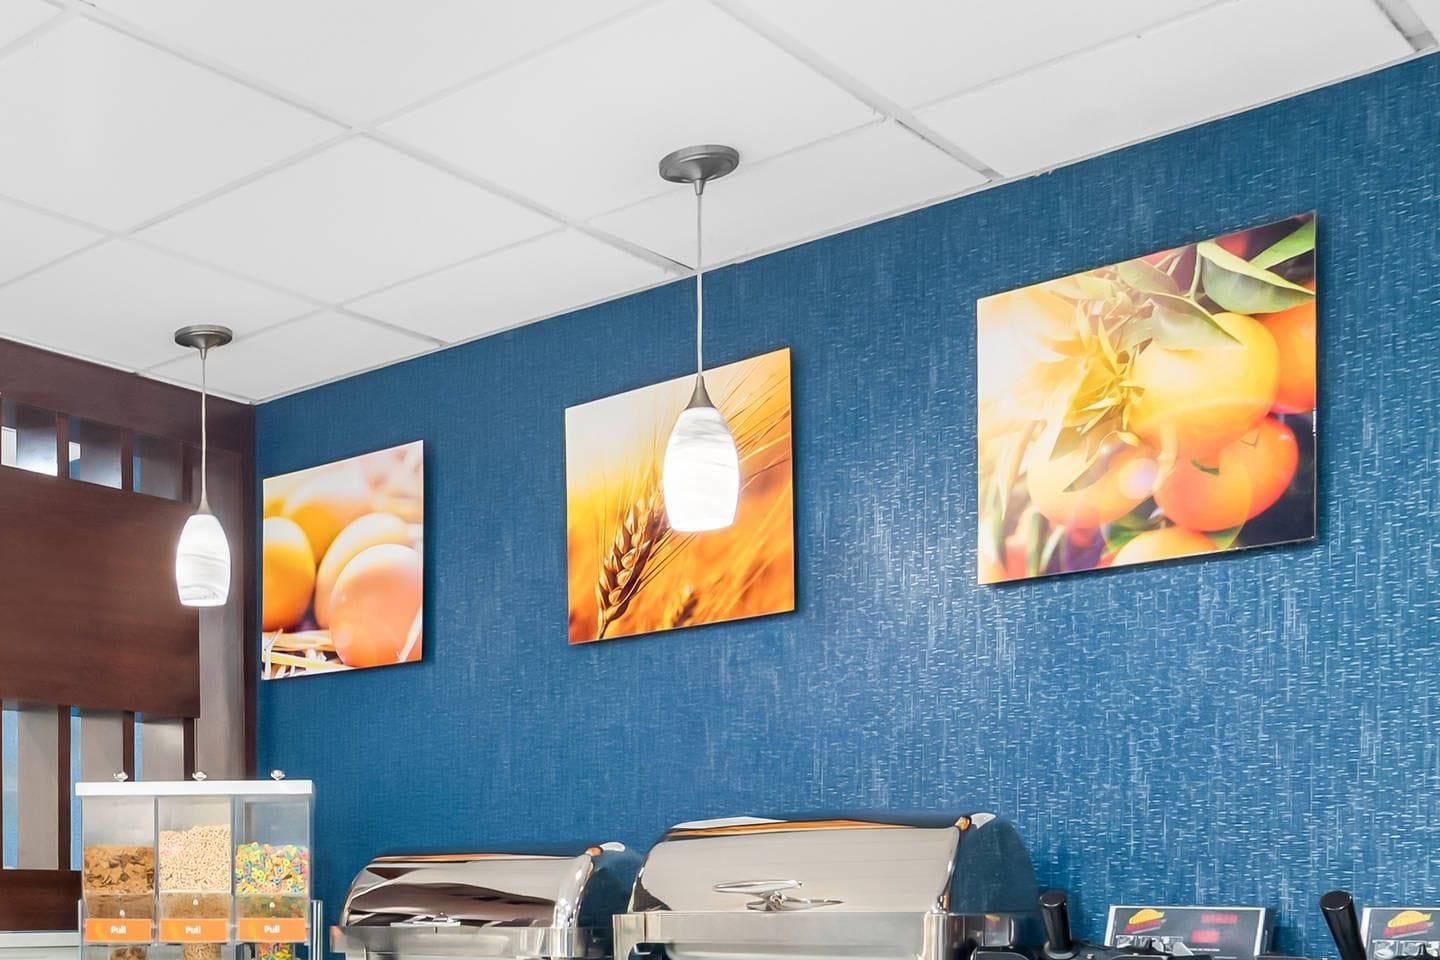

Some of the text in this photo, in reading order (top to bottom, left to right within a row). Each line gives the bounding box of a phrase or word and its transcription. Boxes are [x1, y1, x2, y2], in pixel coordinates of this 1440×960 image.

[110, 925, 127, 934] Pull
[185, 926, 201, 935] Pull
[263, 924, 280, 934] Pull
